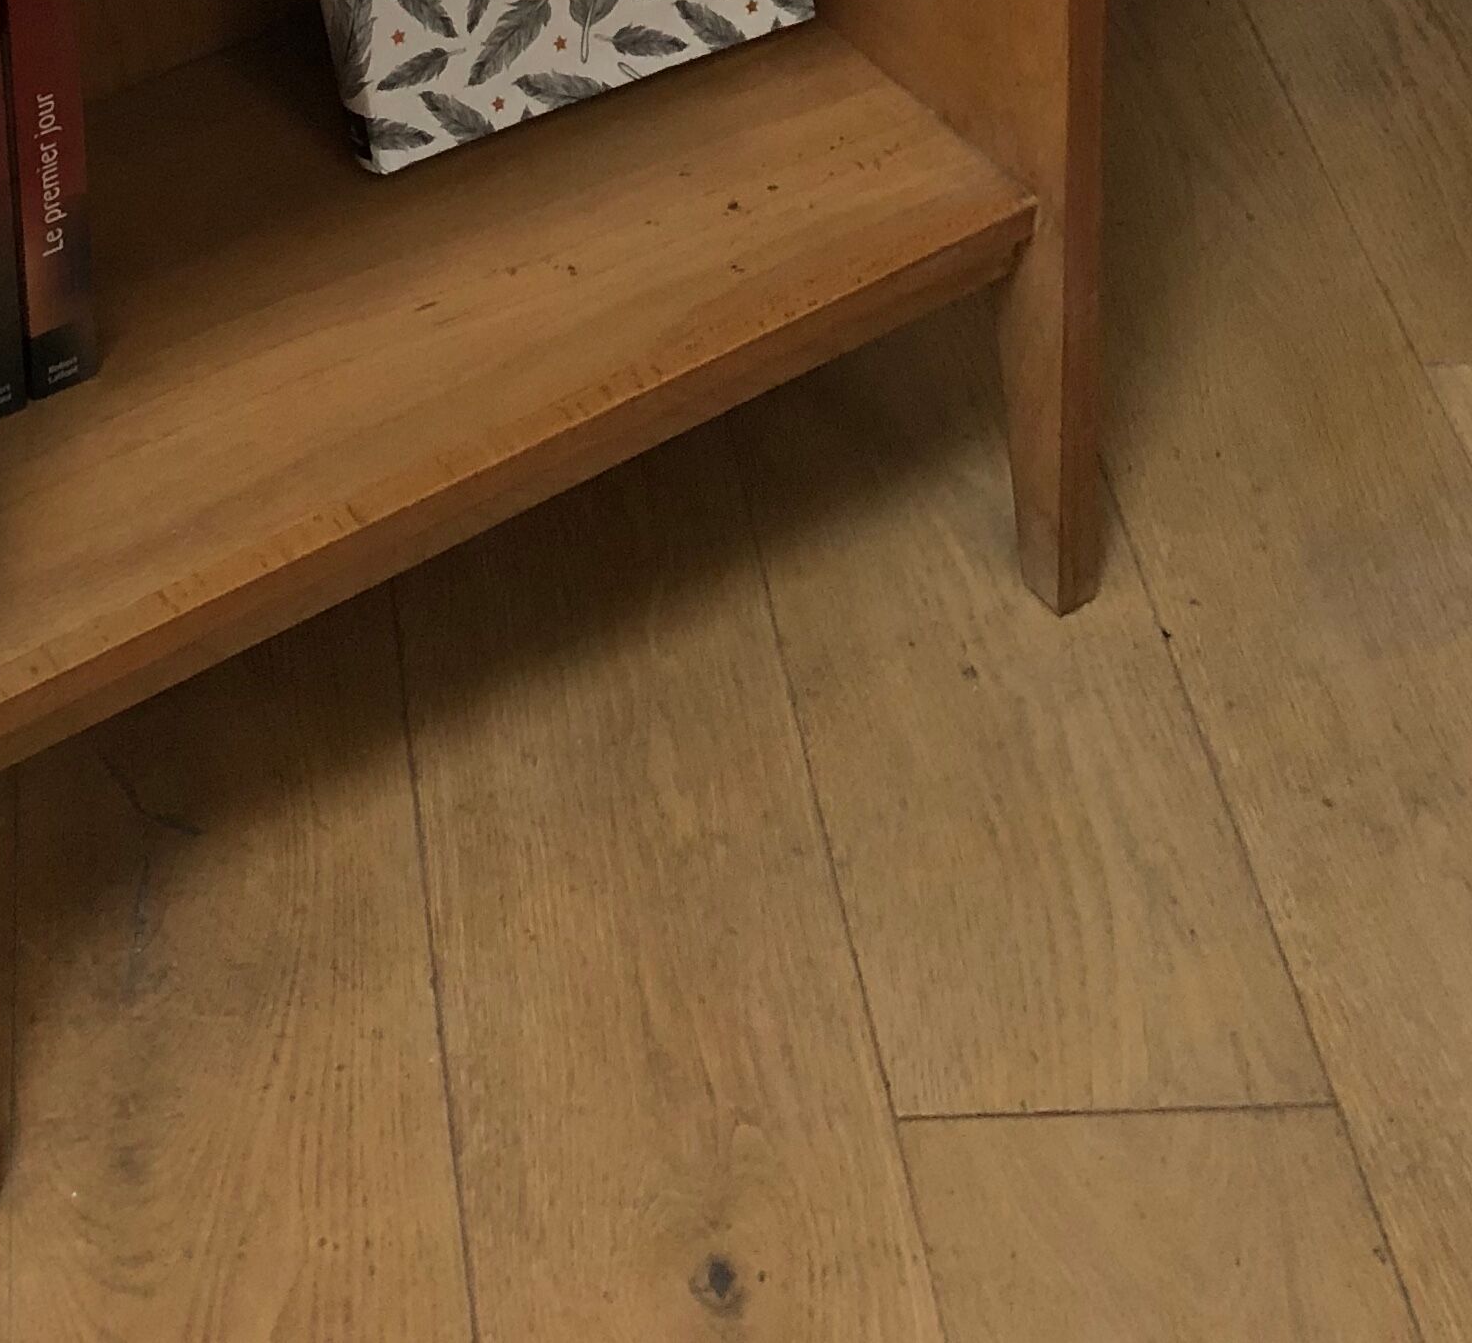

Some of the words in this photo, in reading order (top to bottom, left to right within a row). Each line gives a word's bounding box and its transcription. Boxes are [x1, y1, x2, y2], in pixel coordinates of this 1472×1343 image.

[34, 92, 64, 138] jour
[41, 137, 68, 223] premier
[42, 227, 64, 257] Le
